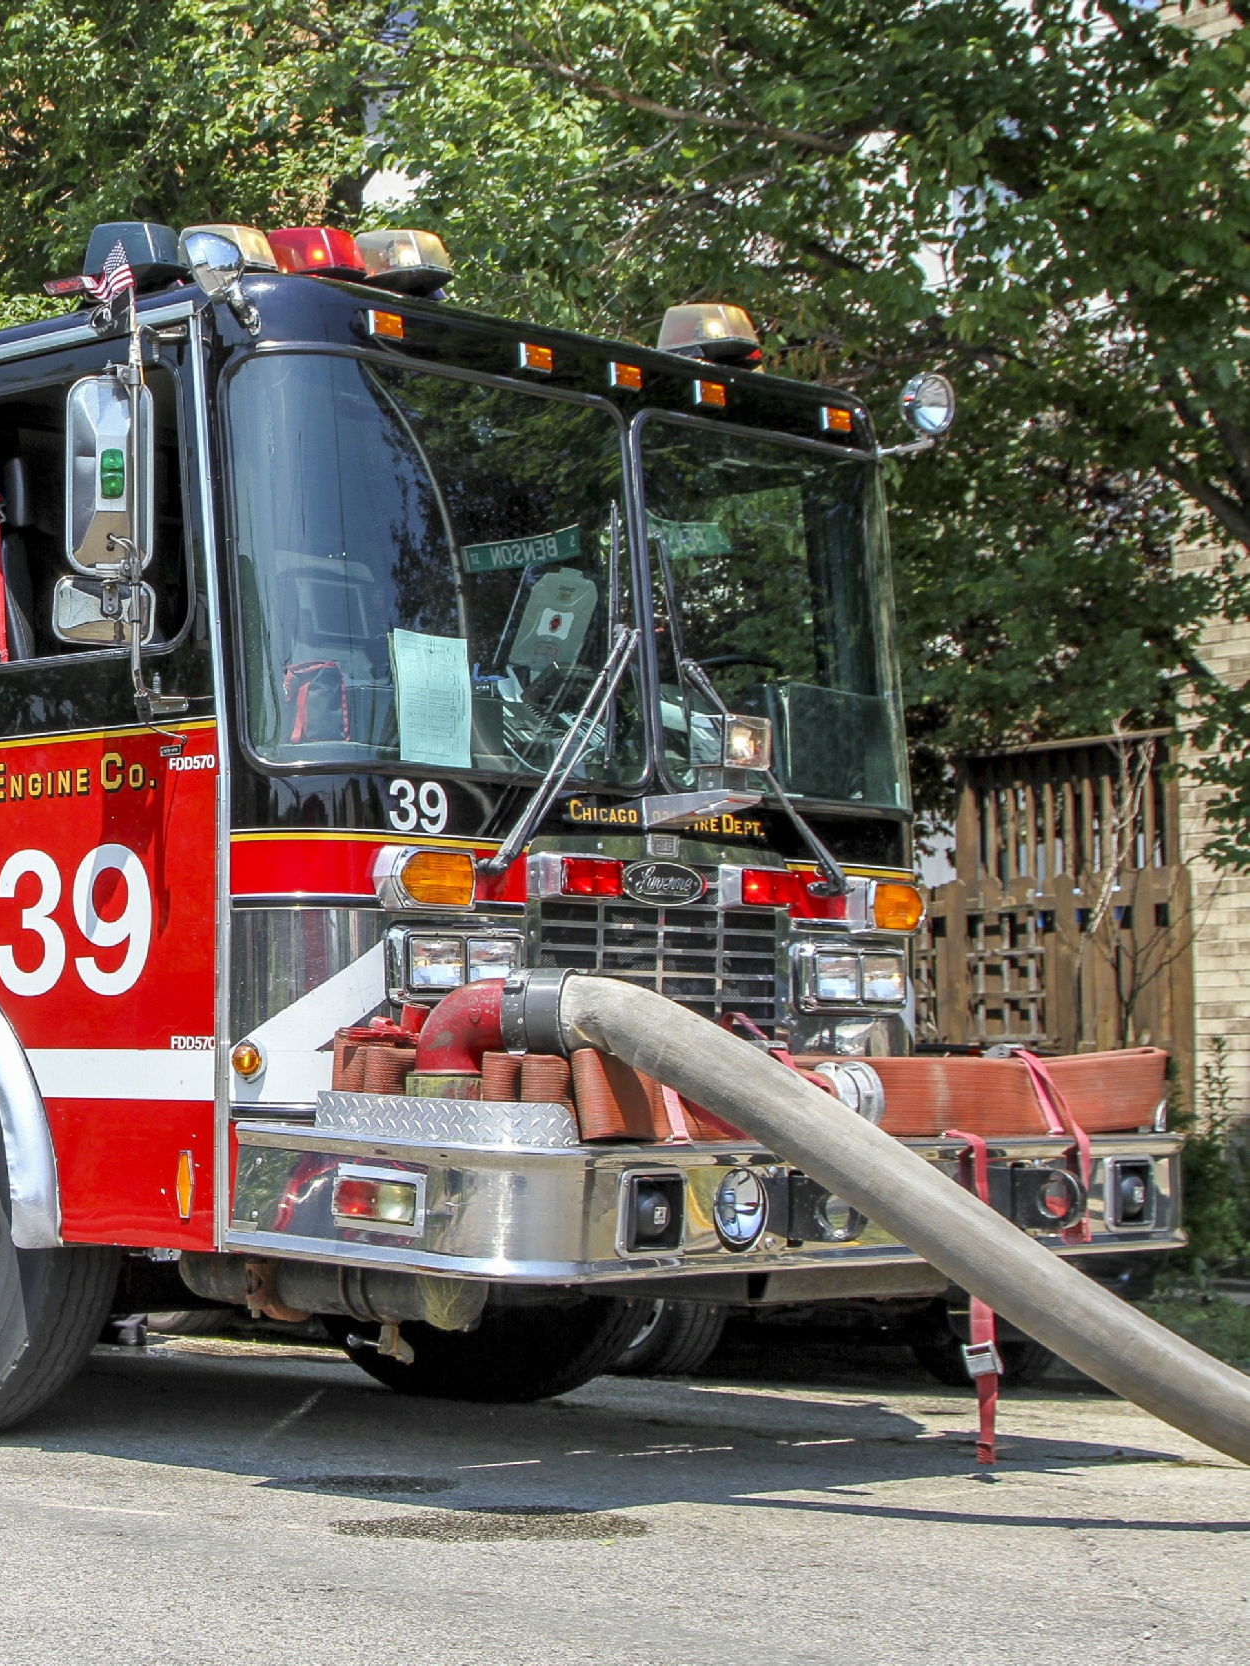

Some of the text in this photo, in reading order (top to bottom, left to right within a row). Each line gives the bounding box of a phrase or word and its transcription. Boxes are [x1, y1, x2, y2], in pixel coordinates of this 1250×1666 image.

[169, 754, 216, 771] FDD570
[389, 779, 449, 834] 39
[569, 799, 639, 825] CHICAGO
[685, 815, 720, 833] IRE
[722, 814, 766, 837] DEPT.
[171, 1035, 216, 1050] FDD570
